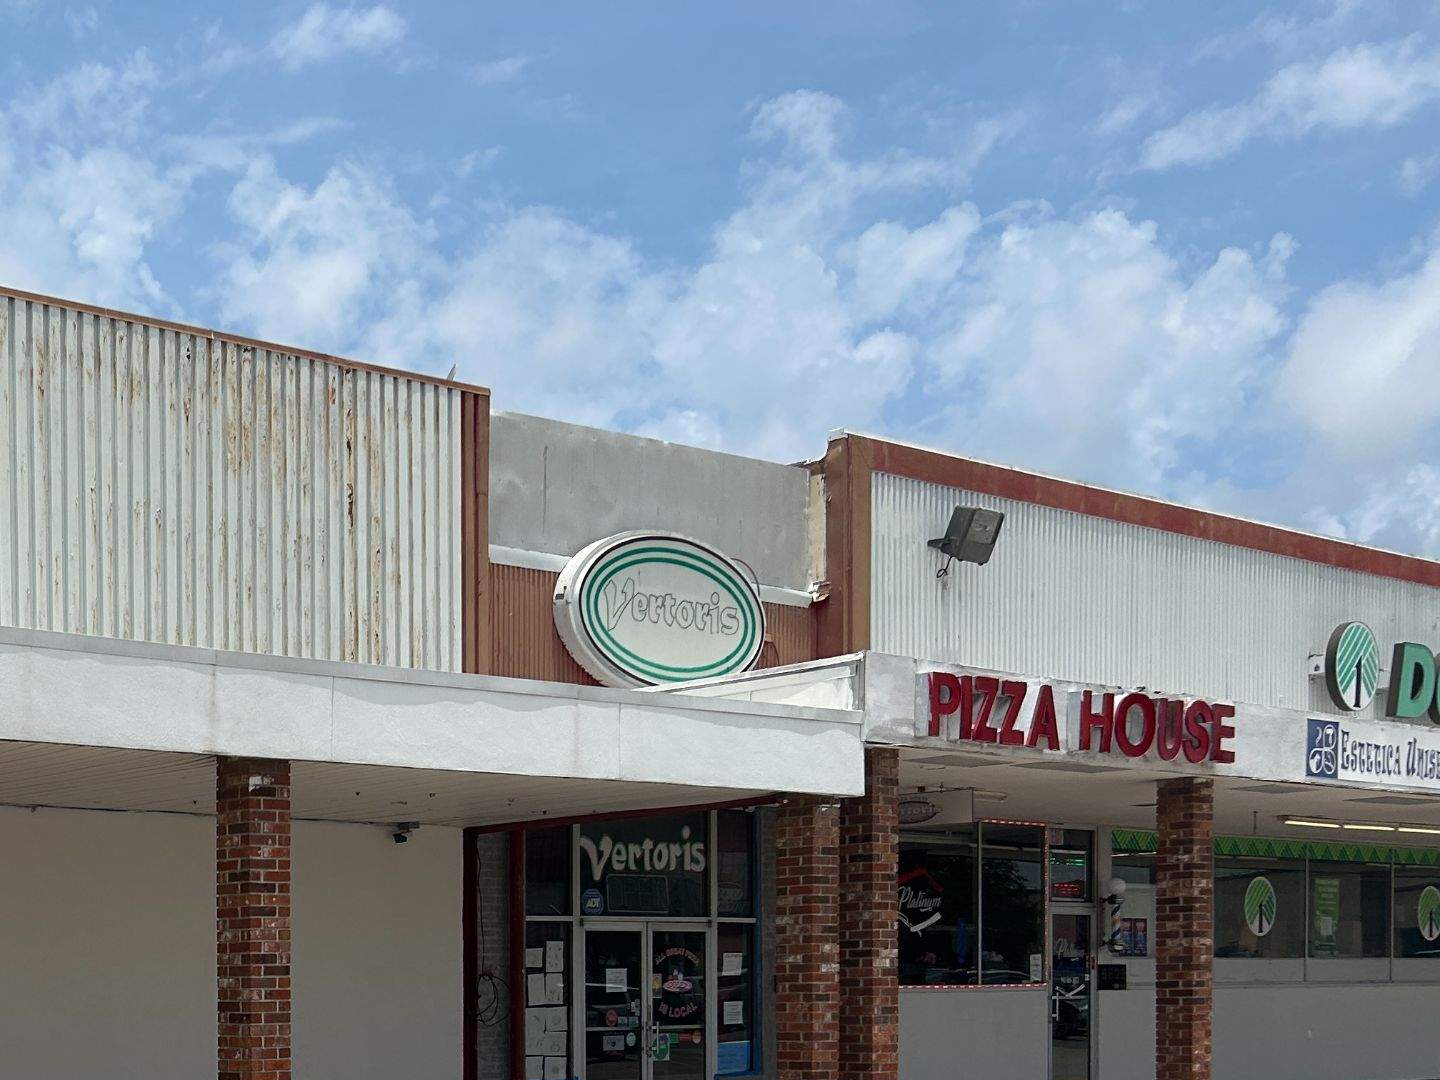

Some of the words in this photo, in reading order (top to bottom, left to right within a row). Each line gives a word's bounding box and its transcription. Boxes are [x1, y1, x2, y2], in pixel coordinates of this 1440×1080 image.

[603, 577, 740, 636] Vertoris
[1386, 641, 1440, 725] D
[928, 671, 1060, 750] PIZZA
[1079, 689, 1236, 763] HOUSE
[579, 825, 706, 881] Vertoris
[585, 897, 601, 908] ADT
[897, 886, 942, 912] Platinum
[668, 1002, 698, 1019] LOCAL
